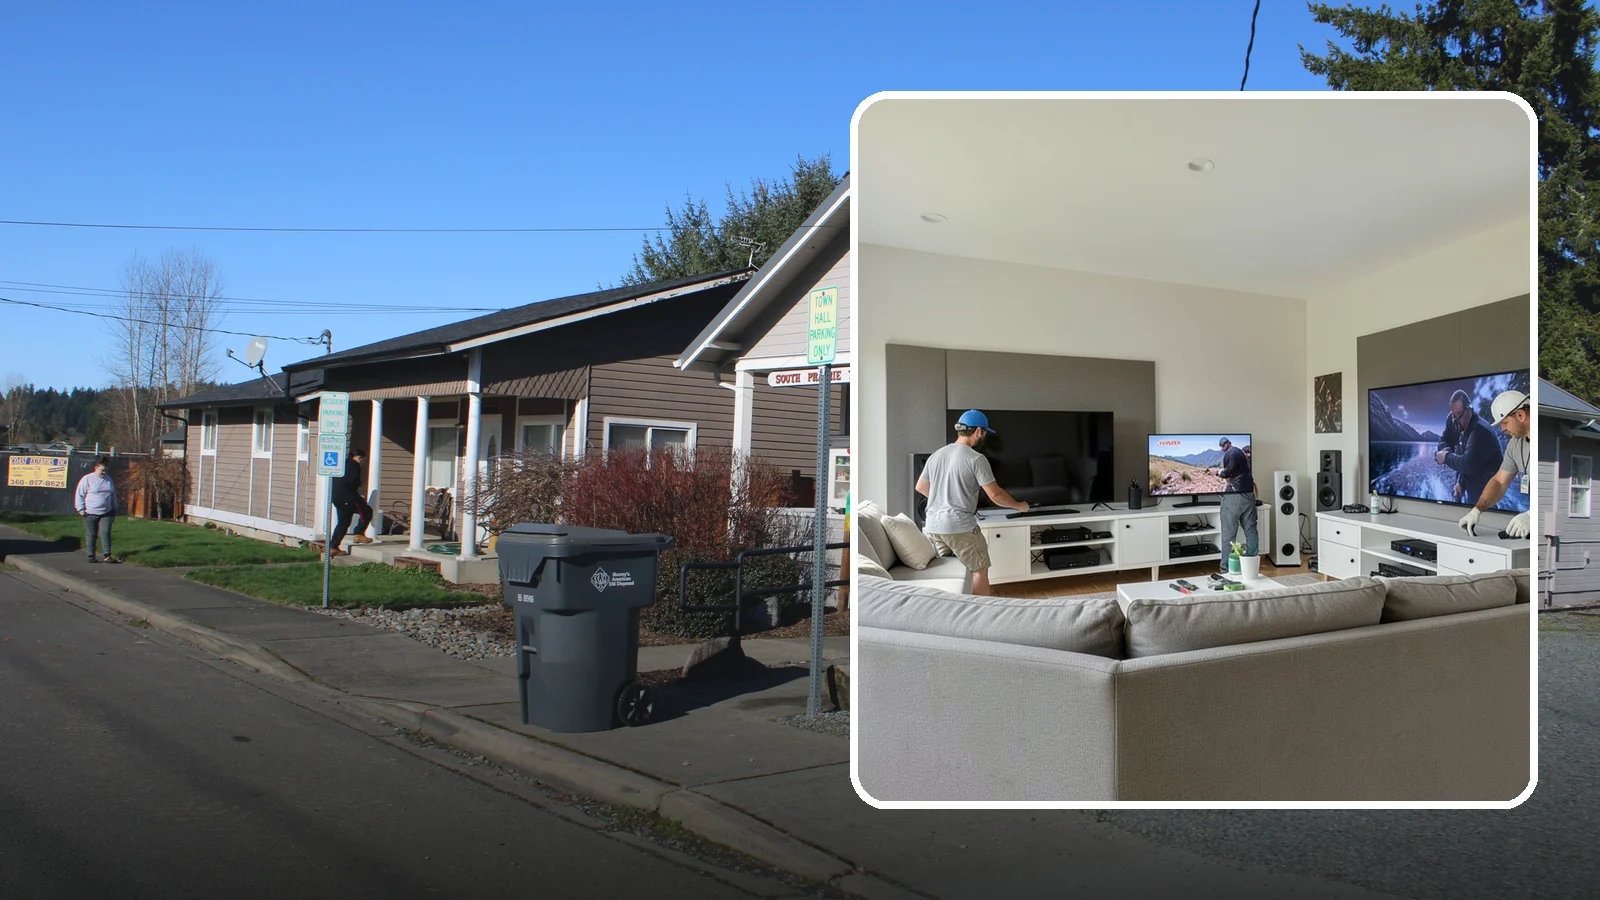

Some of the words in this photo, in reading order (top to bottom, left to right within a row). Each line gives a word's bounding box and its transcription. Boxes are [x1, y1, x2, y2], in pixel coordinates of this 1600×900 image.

[815, 294, 833, 308] TOWN
[814, 311, 831, 325] HALL
[810, 326, 836, 341] PARKING
[813, 344, 831, 357] ONLY
[776, 374, 801, 384] SOUTH
